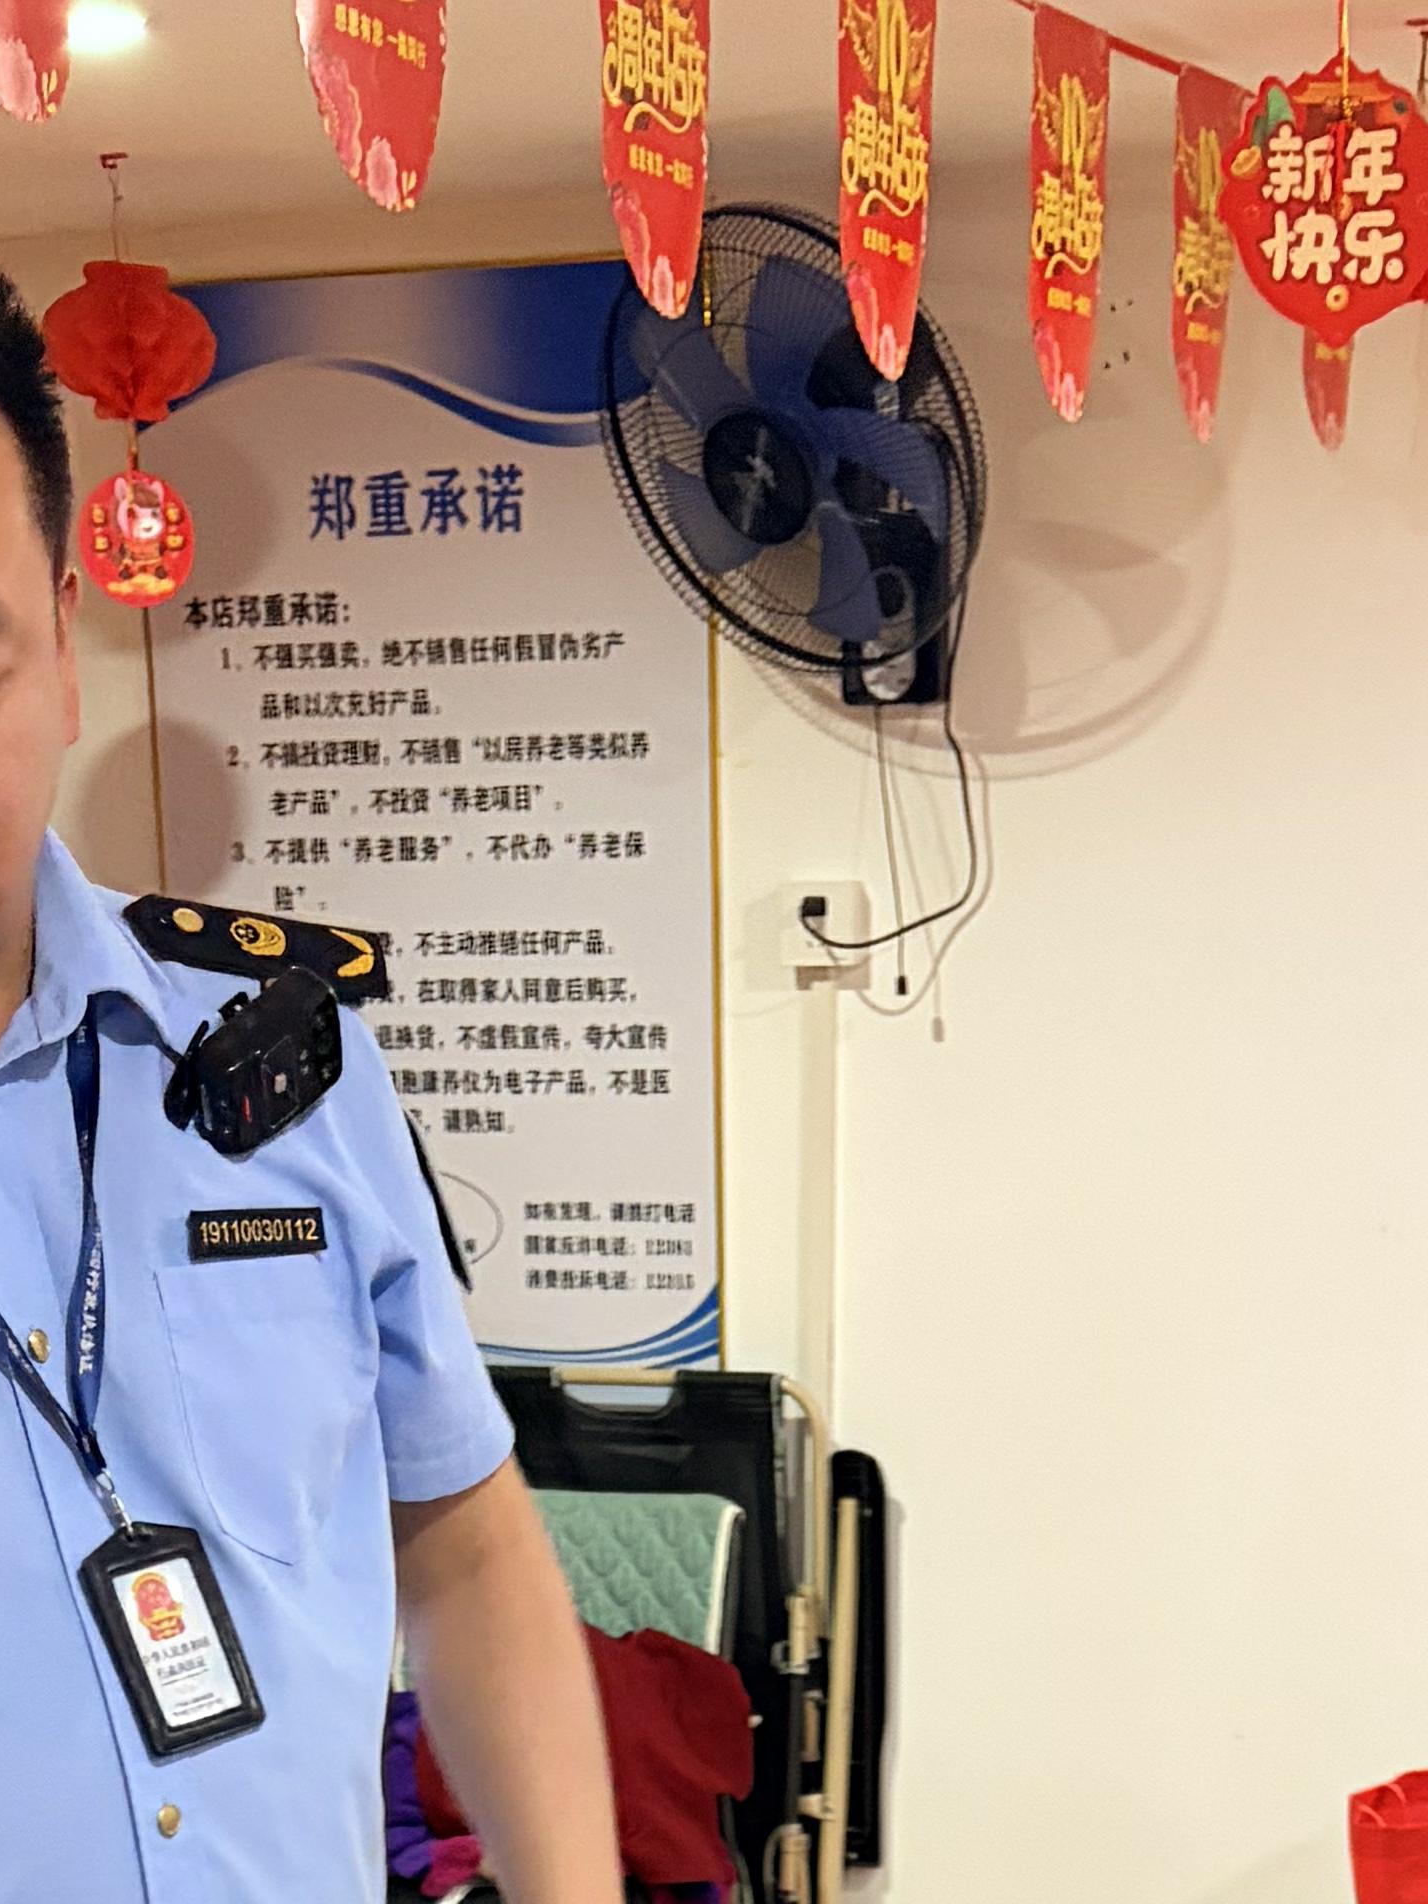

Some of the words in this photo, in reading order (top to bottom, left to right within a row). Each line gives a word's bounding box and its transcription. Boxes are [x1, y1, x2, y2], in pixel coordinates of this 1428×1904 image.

[1263, 124, 1404, 204] 新年
[1259, 208, 1404, 285] 快乐
[309, 463, 525, 540] 郑重承诺
[200, 1218, 320, 1245] 19110030112
